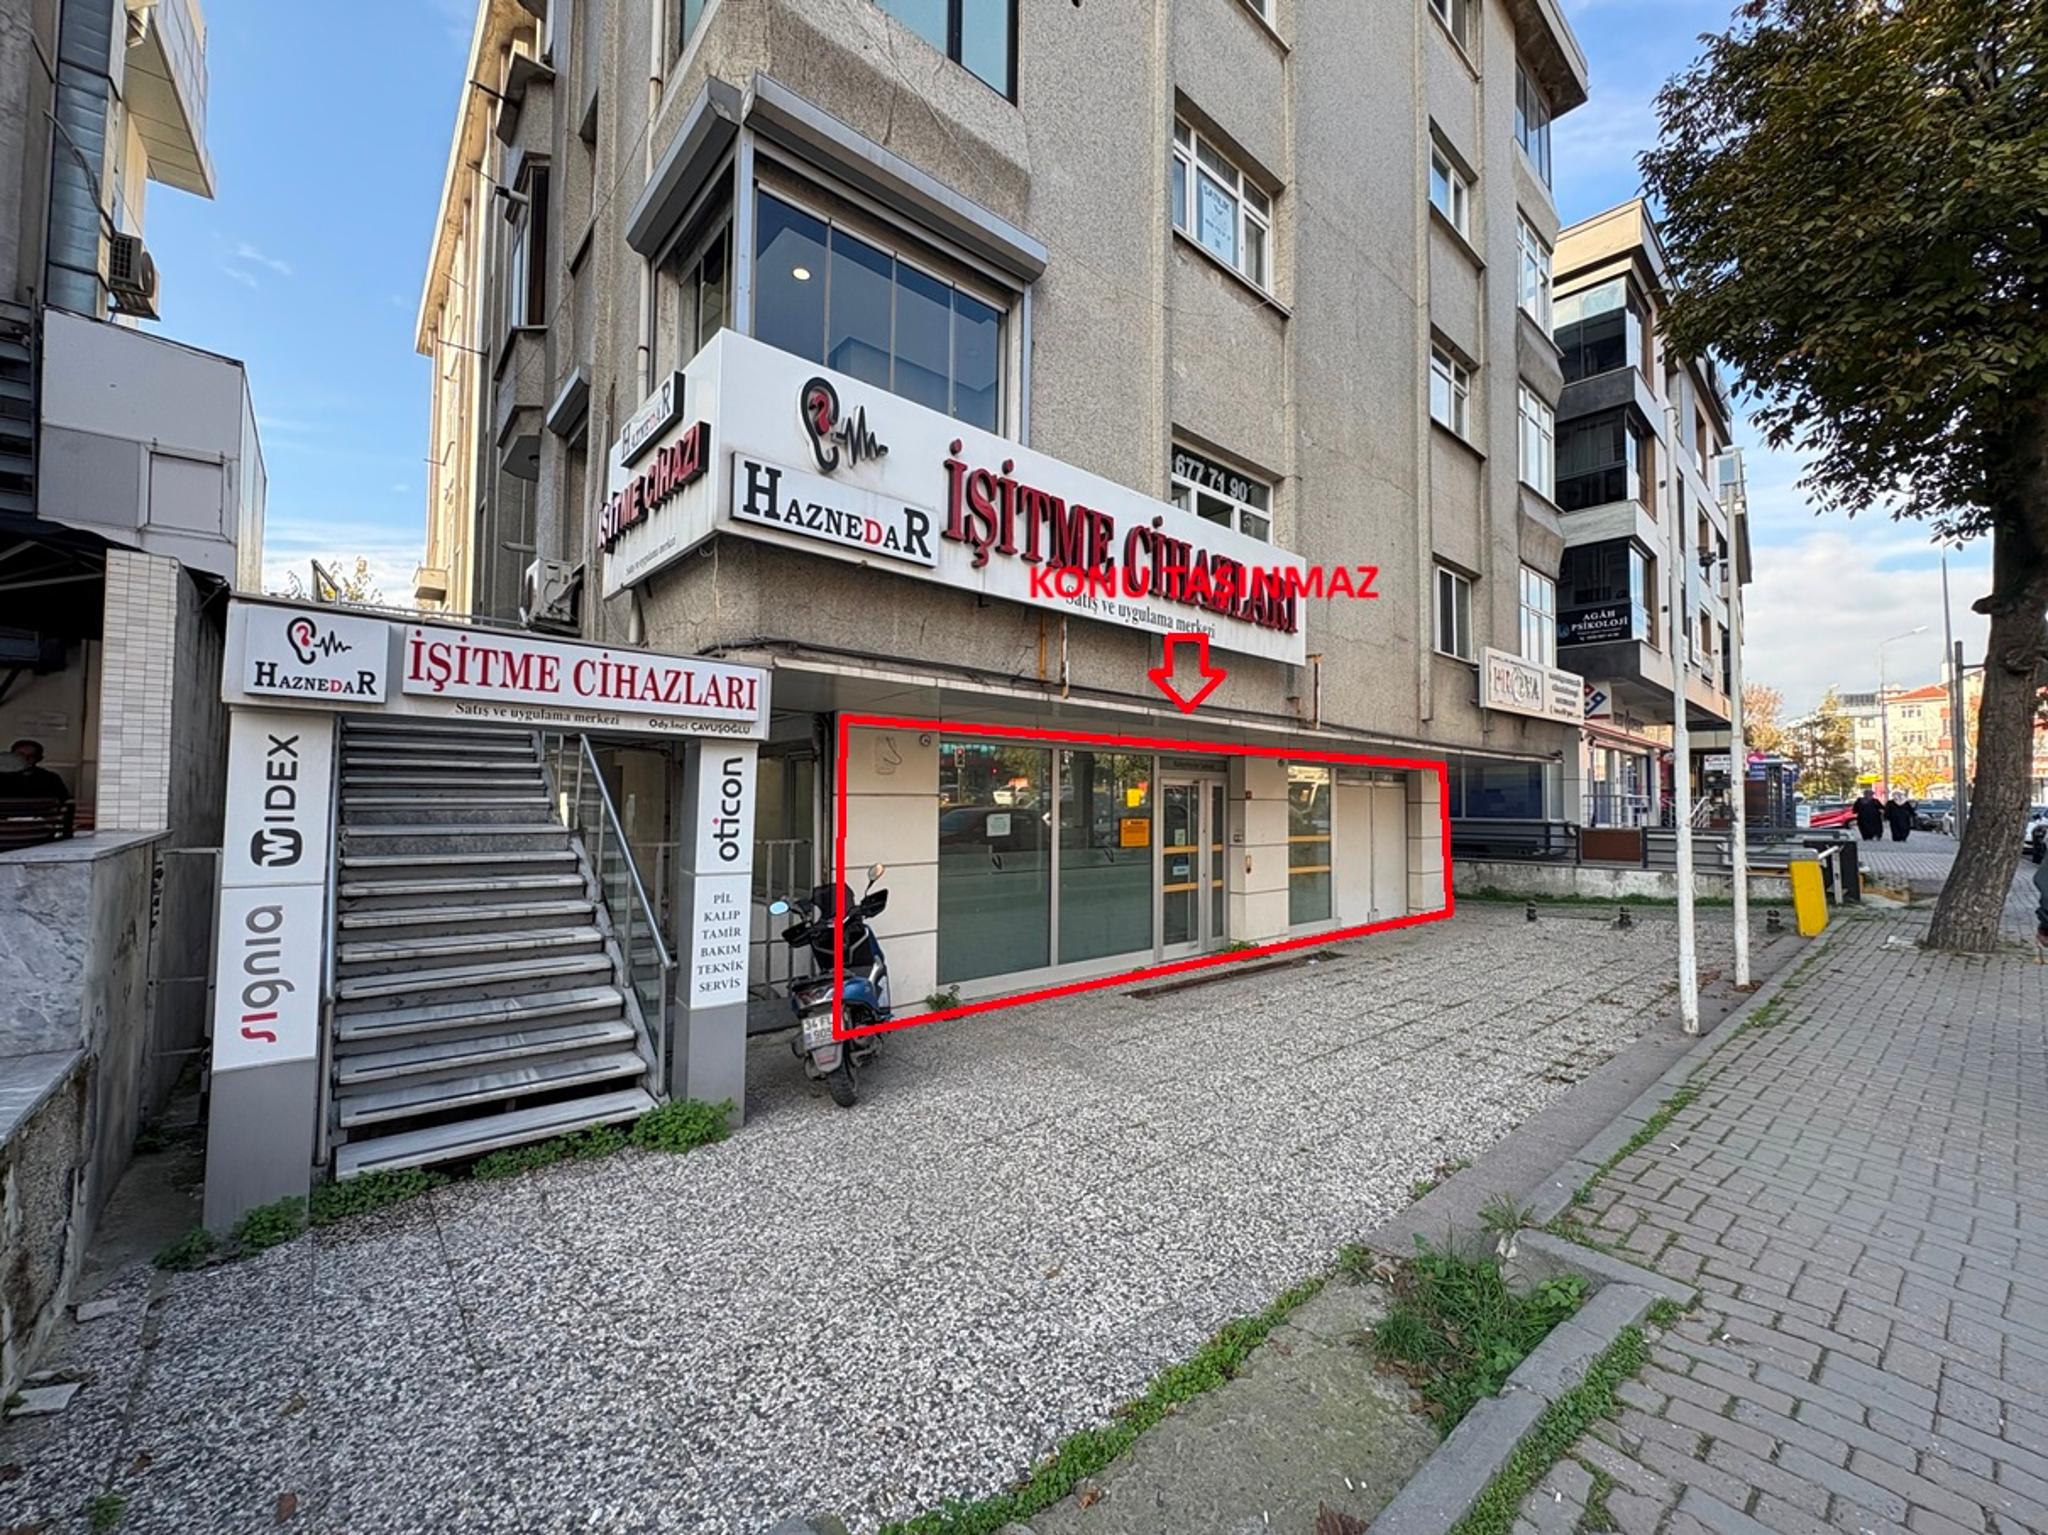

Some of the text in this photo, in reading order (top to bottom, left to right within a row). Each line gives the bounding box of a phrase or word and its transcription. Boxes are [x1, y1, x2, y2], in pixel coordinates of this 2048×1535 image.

[1175, 454, 1248, 502] 677 71 90
[742, 460, 932, 559] HAZNEDAR
[941, 438, 1115, 577] İŞİTME
[1102, 600, 1115, 616] ve
[1118, 604, 1173, 629] uygulama
[254, 661, 377, 697] HAZNEDAR
[408, 629, 758, 711] İŞİTME CİHAZLARI
[455, 702, 620, 725] Satış ve uygulama merkezi
[250, 734, 303, 867] WIDEX
[713, 757, 743, 862] oticon
[714, 891, 734, 904] PİL
[701, 925, 742, 940] TAMİR
[704, 910, 741, 923] KALIP
[700, 944, 741, 957] BAKIM
[241, 905, 295, 1043] signia
[697, 960, 744, 976] TEKNİK
[698, 978, 741, 993] SERVİS
